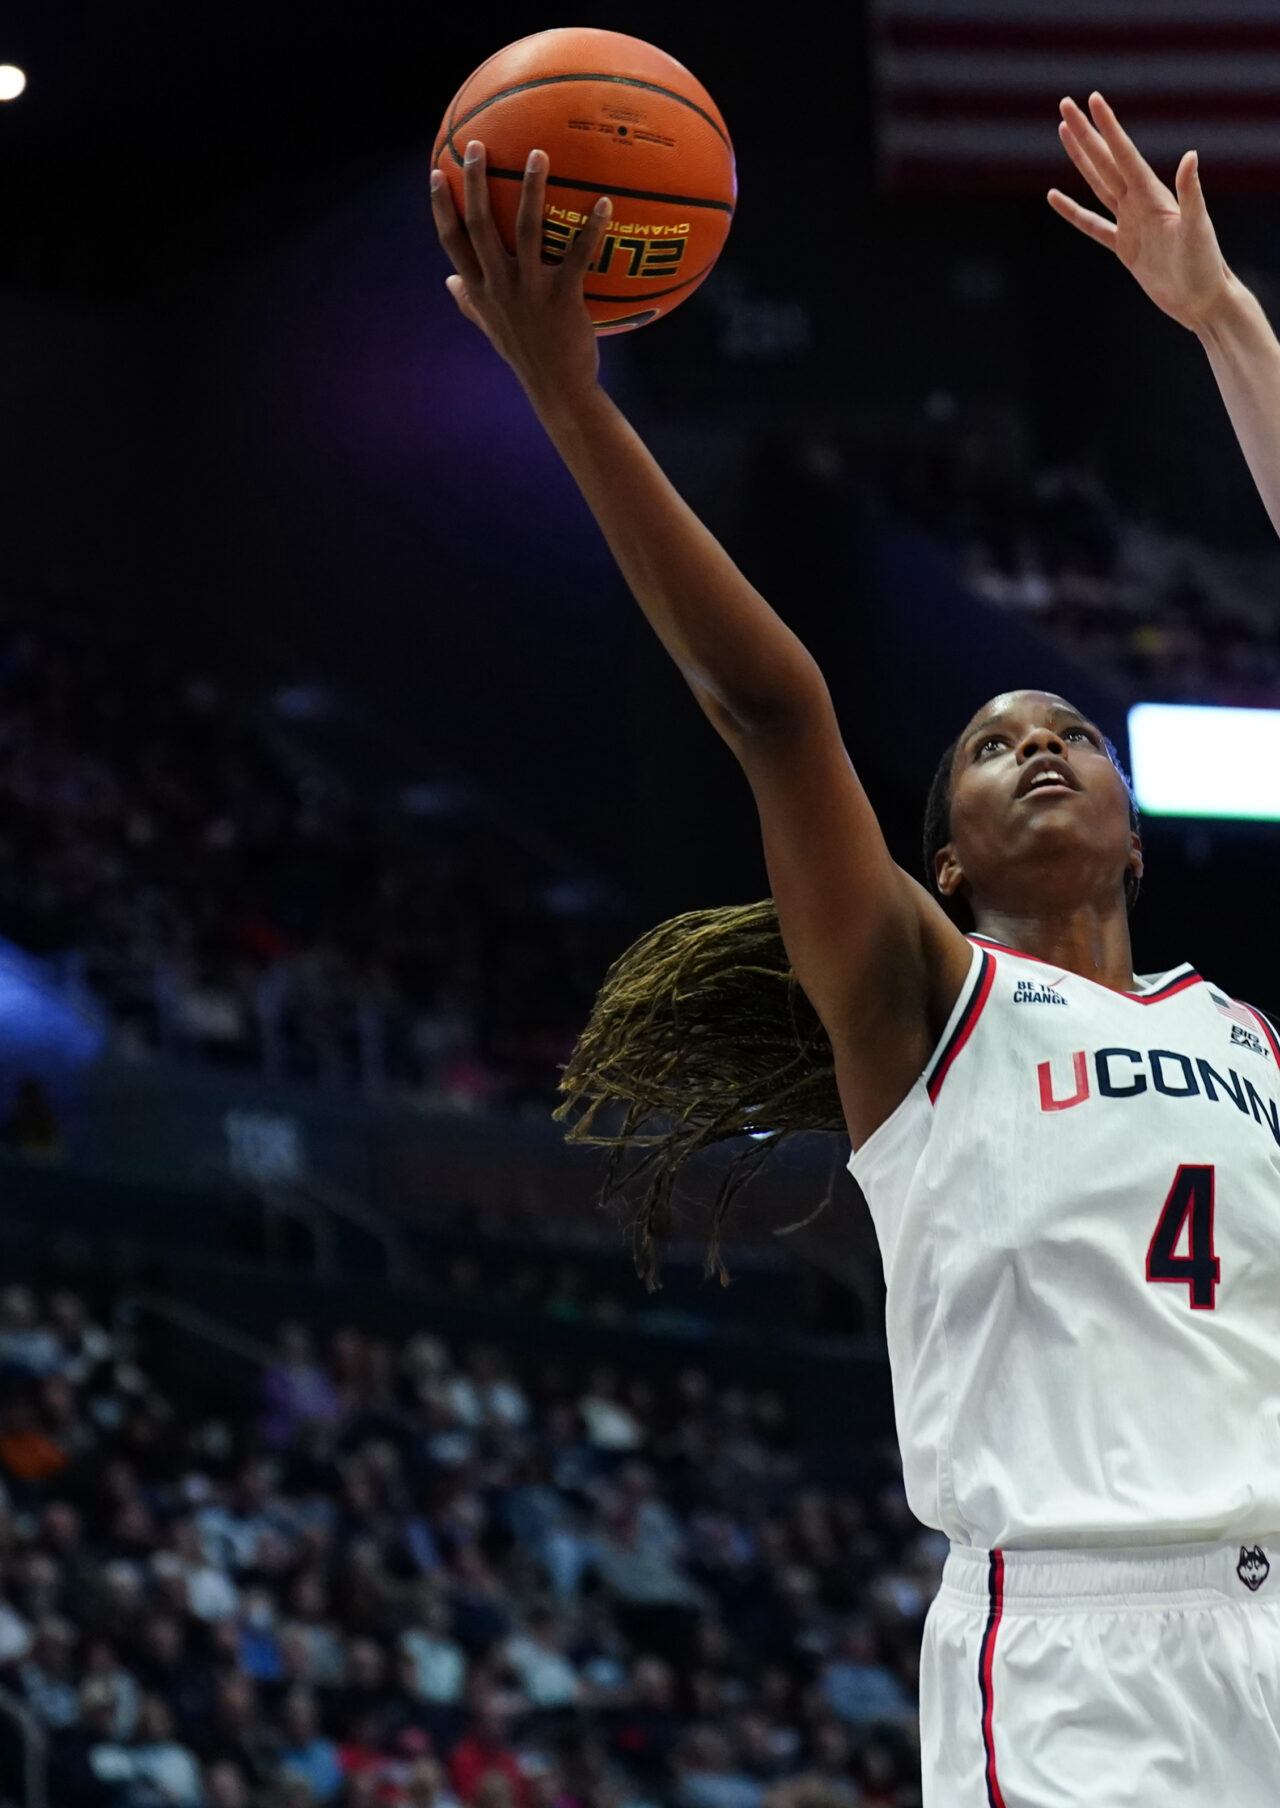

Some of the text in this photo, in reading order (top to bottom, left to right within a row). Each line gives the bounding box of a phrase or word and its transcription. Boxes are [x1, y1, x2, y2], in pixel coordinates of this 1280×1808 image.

[1017, 981, 1035, 991] BE
[1013, 991, 1069, 1006] CHANGE
[1232, 1025, 1260, 1044] BIG
[1231, 1033, 1271, 1056] EAST
[1145, 1164, 1221, 1311] 4
